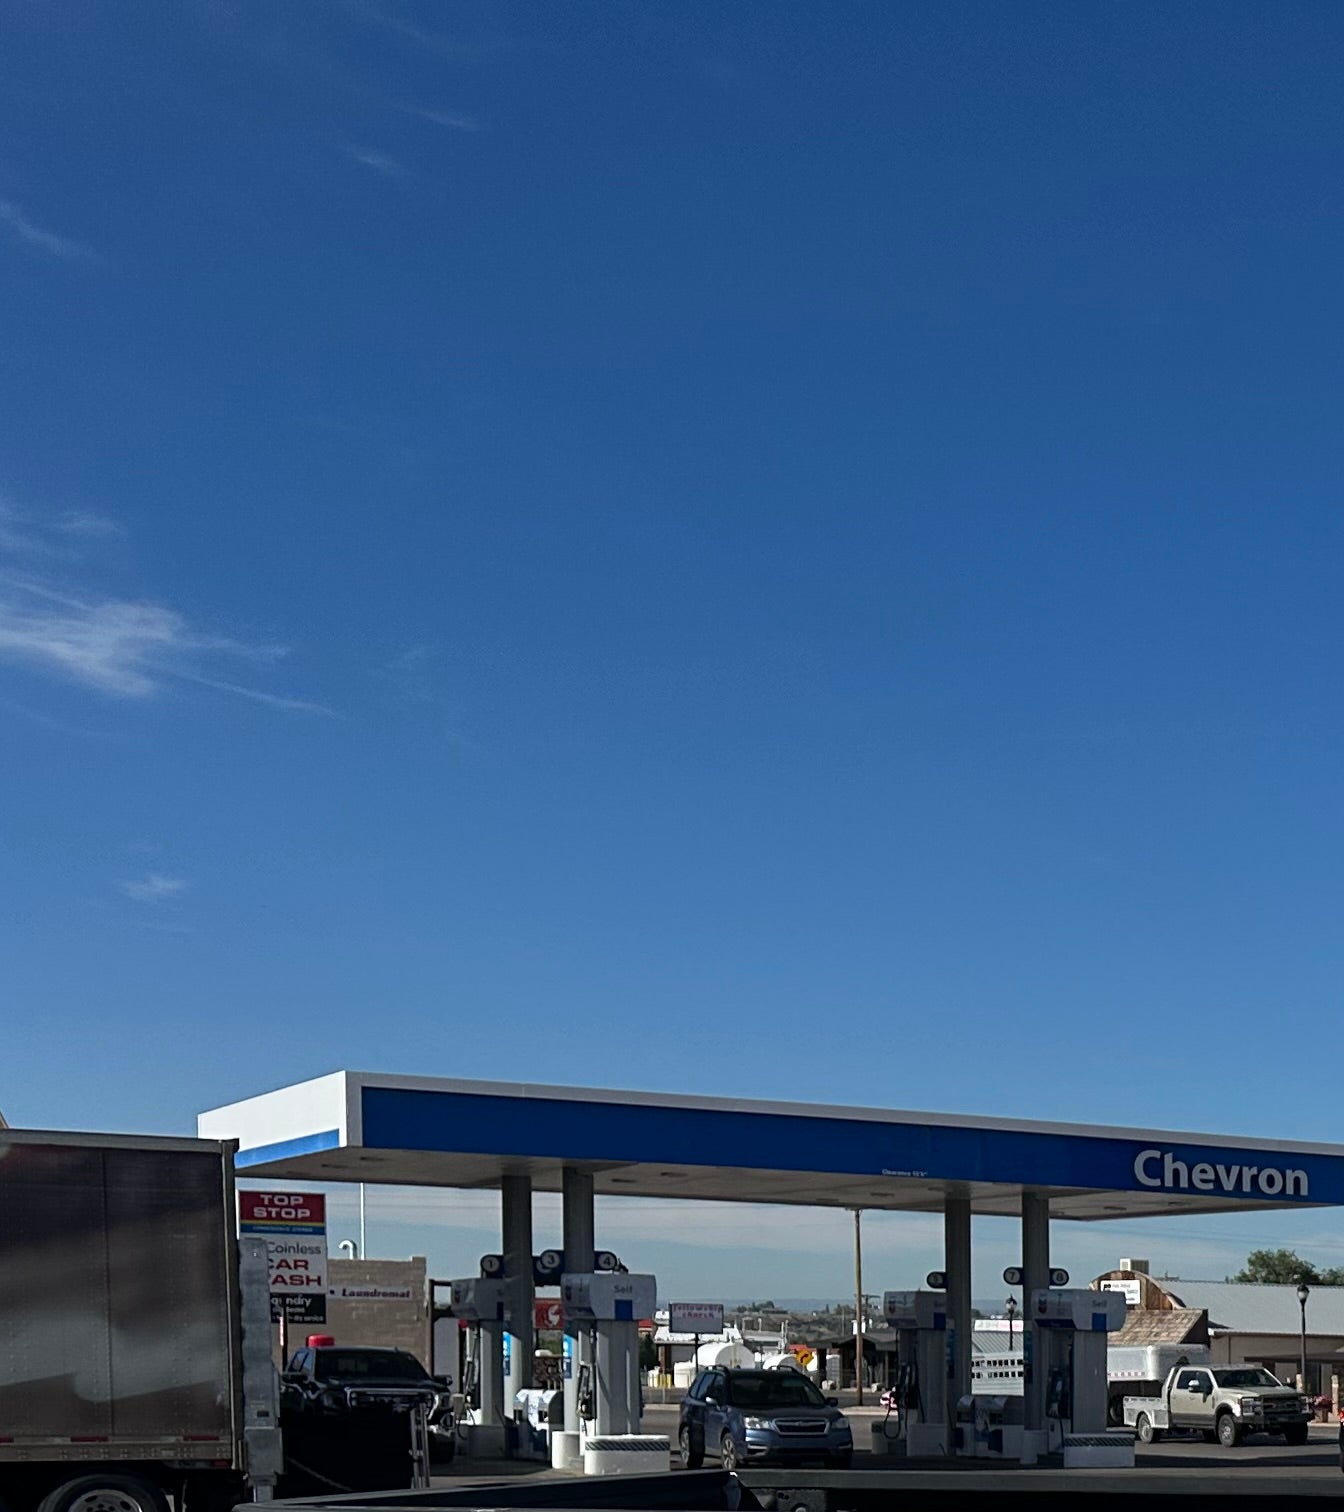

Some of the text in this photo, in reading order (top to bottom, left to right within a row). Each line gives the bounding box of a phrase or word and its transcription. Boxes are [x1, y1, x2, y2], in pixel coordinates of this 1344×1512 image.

[1133, 1149, 1309, 1196] Chevron
[260, 1194, 304, 1206] TOP
[253, 1207, 311, 1219] STOP
[271, 1274, 322, 1286] ASH
[342, 1288, 411, 1299] Laundromat
